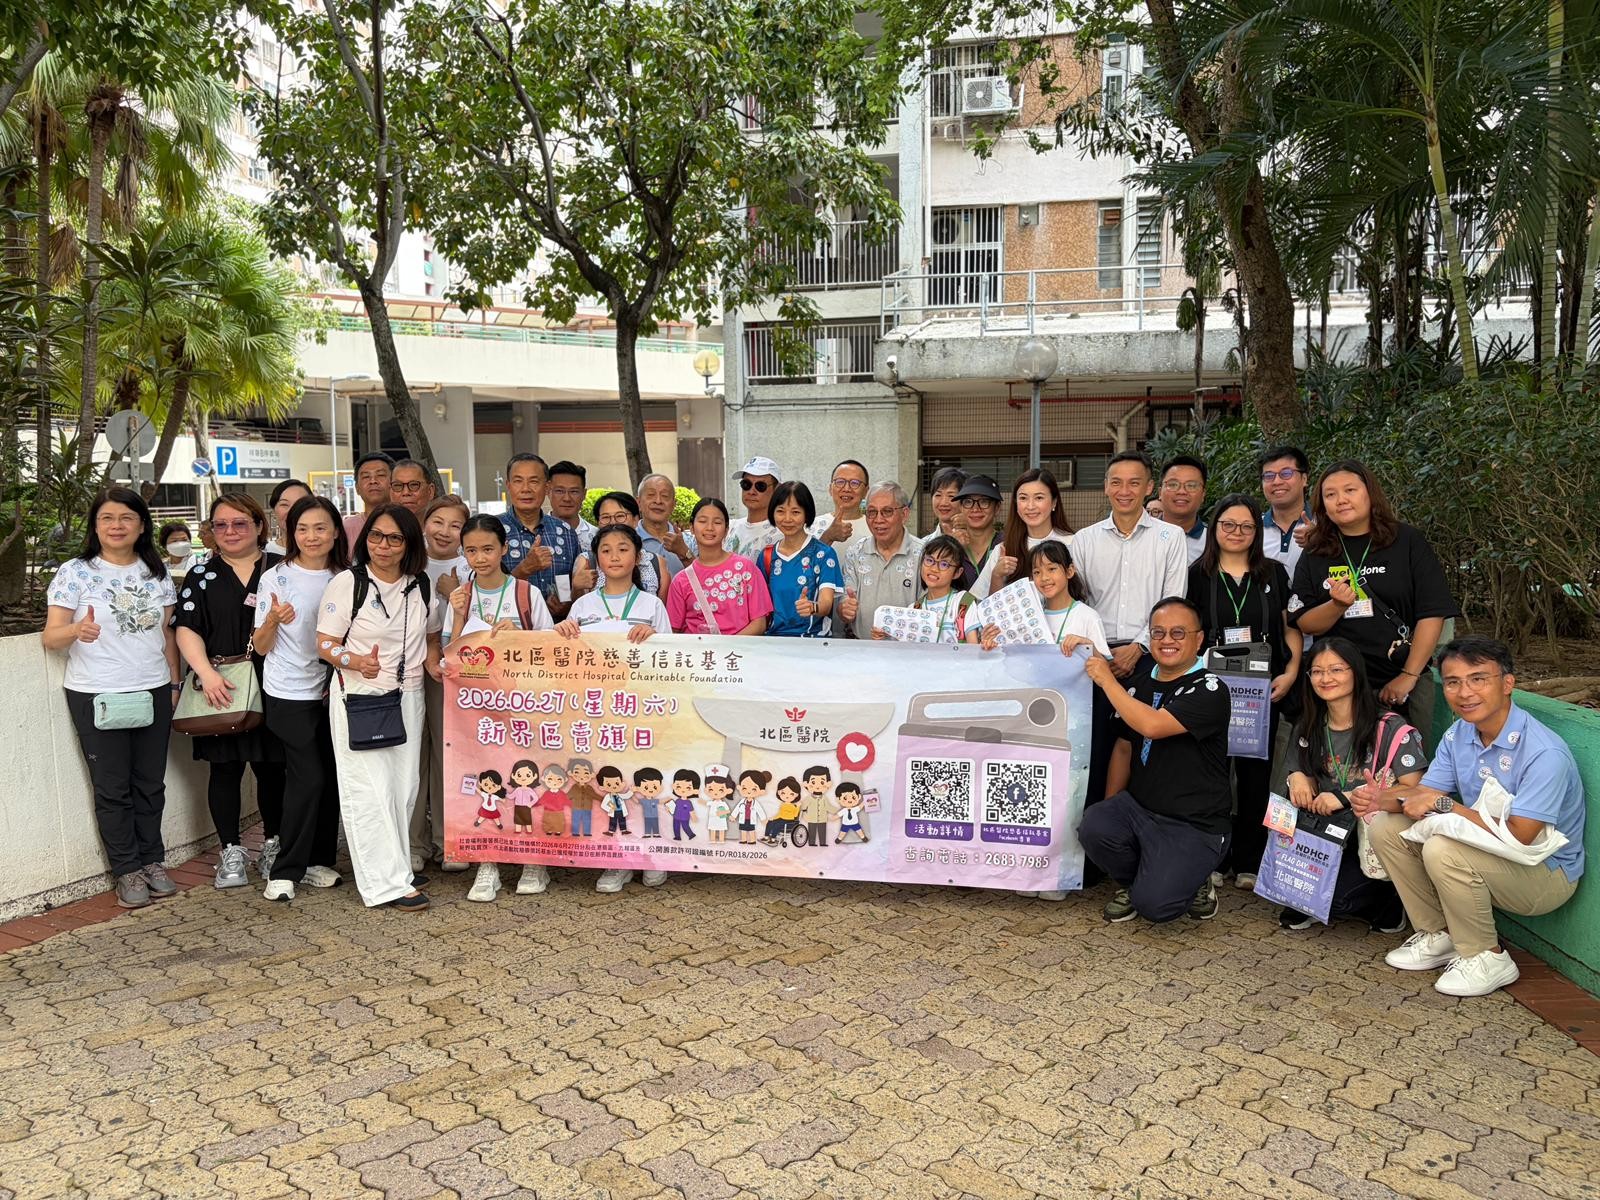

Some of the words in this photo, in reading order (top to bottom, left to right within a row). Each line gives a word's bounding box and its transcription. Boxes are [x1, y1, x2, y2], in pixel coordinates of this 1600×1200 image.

[221, 448, 234, 474] P
[1360, 566, 1386, 575] done
[902, 578, 911, 588] G
[503, 647, 743, 671] 北區醫院慈善信託基金
[502, 669, 533, 679] North
[537, 669, 579, 680] District
[583, 670, 626, 682] Hospital
[630, 671, 686, 682] Charitable
[690, 673, 743, 684] Foundation
[1231, 686, 1264, 695] NDHCF
[478, 718, 655, 752] 新界區賣旗日
[759, 725, 831, 744] 北區醫院
[914, 823, 965, 837] 活動詳情
[648, 845, 714, 857] 公開籌款許可證編號
[715, 850, 768, 859] FD/R018/2026
[1295, 843, 1330, 861] NDHCF
[985, 852, 1016, 867] 2683
[1020, 855, 1050, 868] 7985
